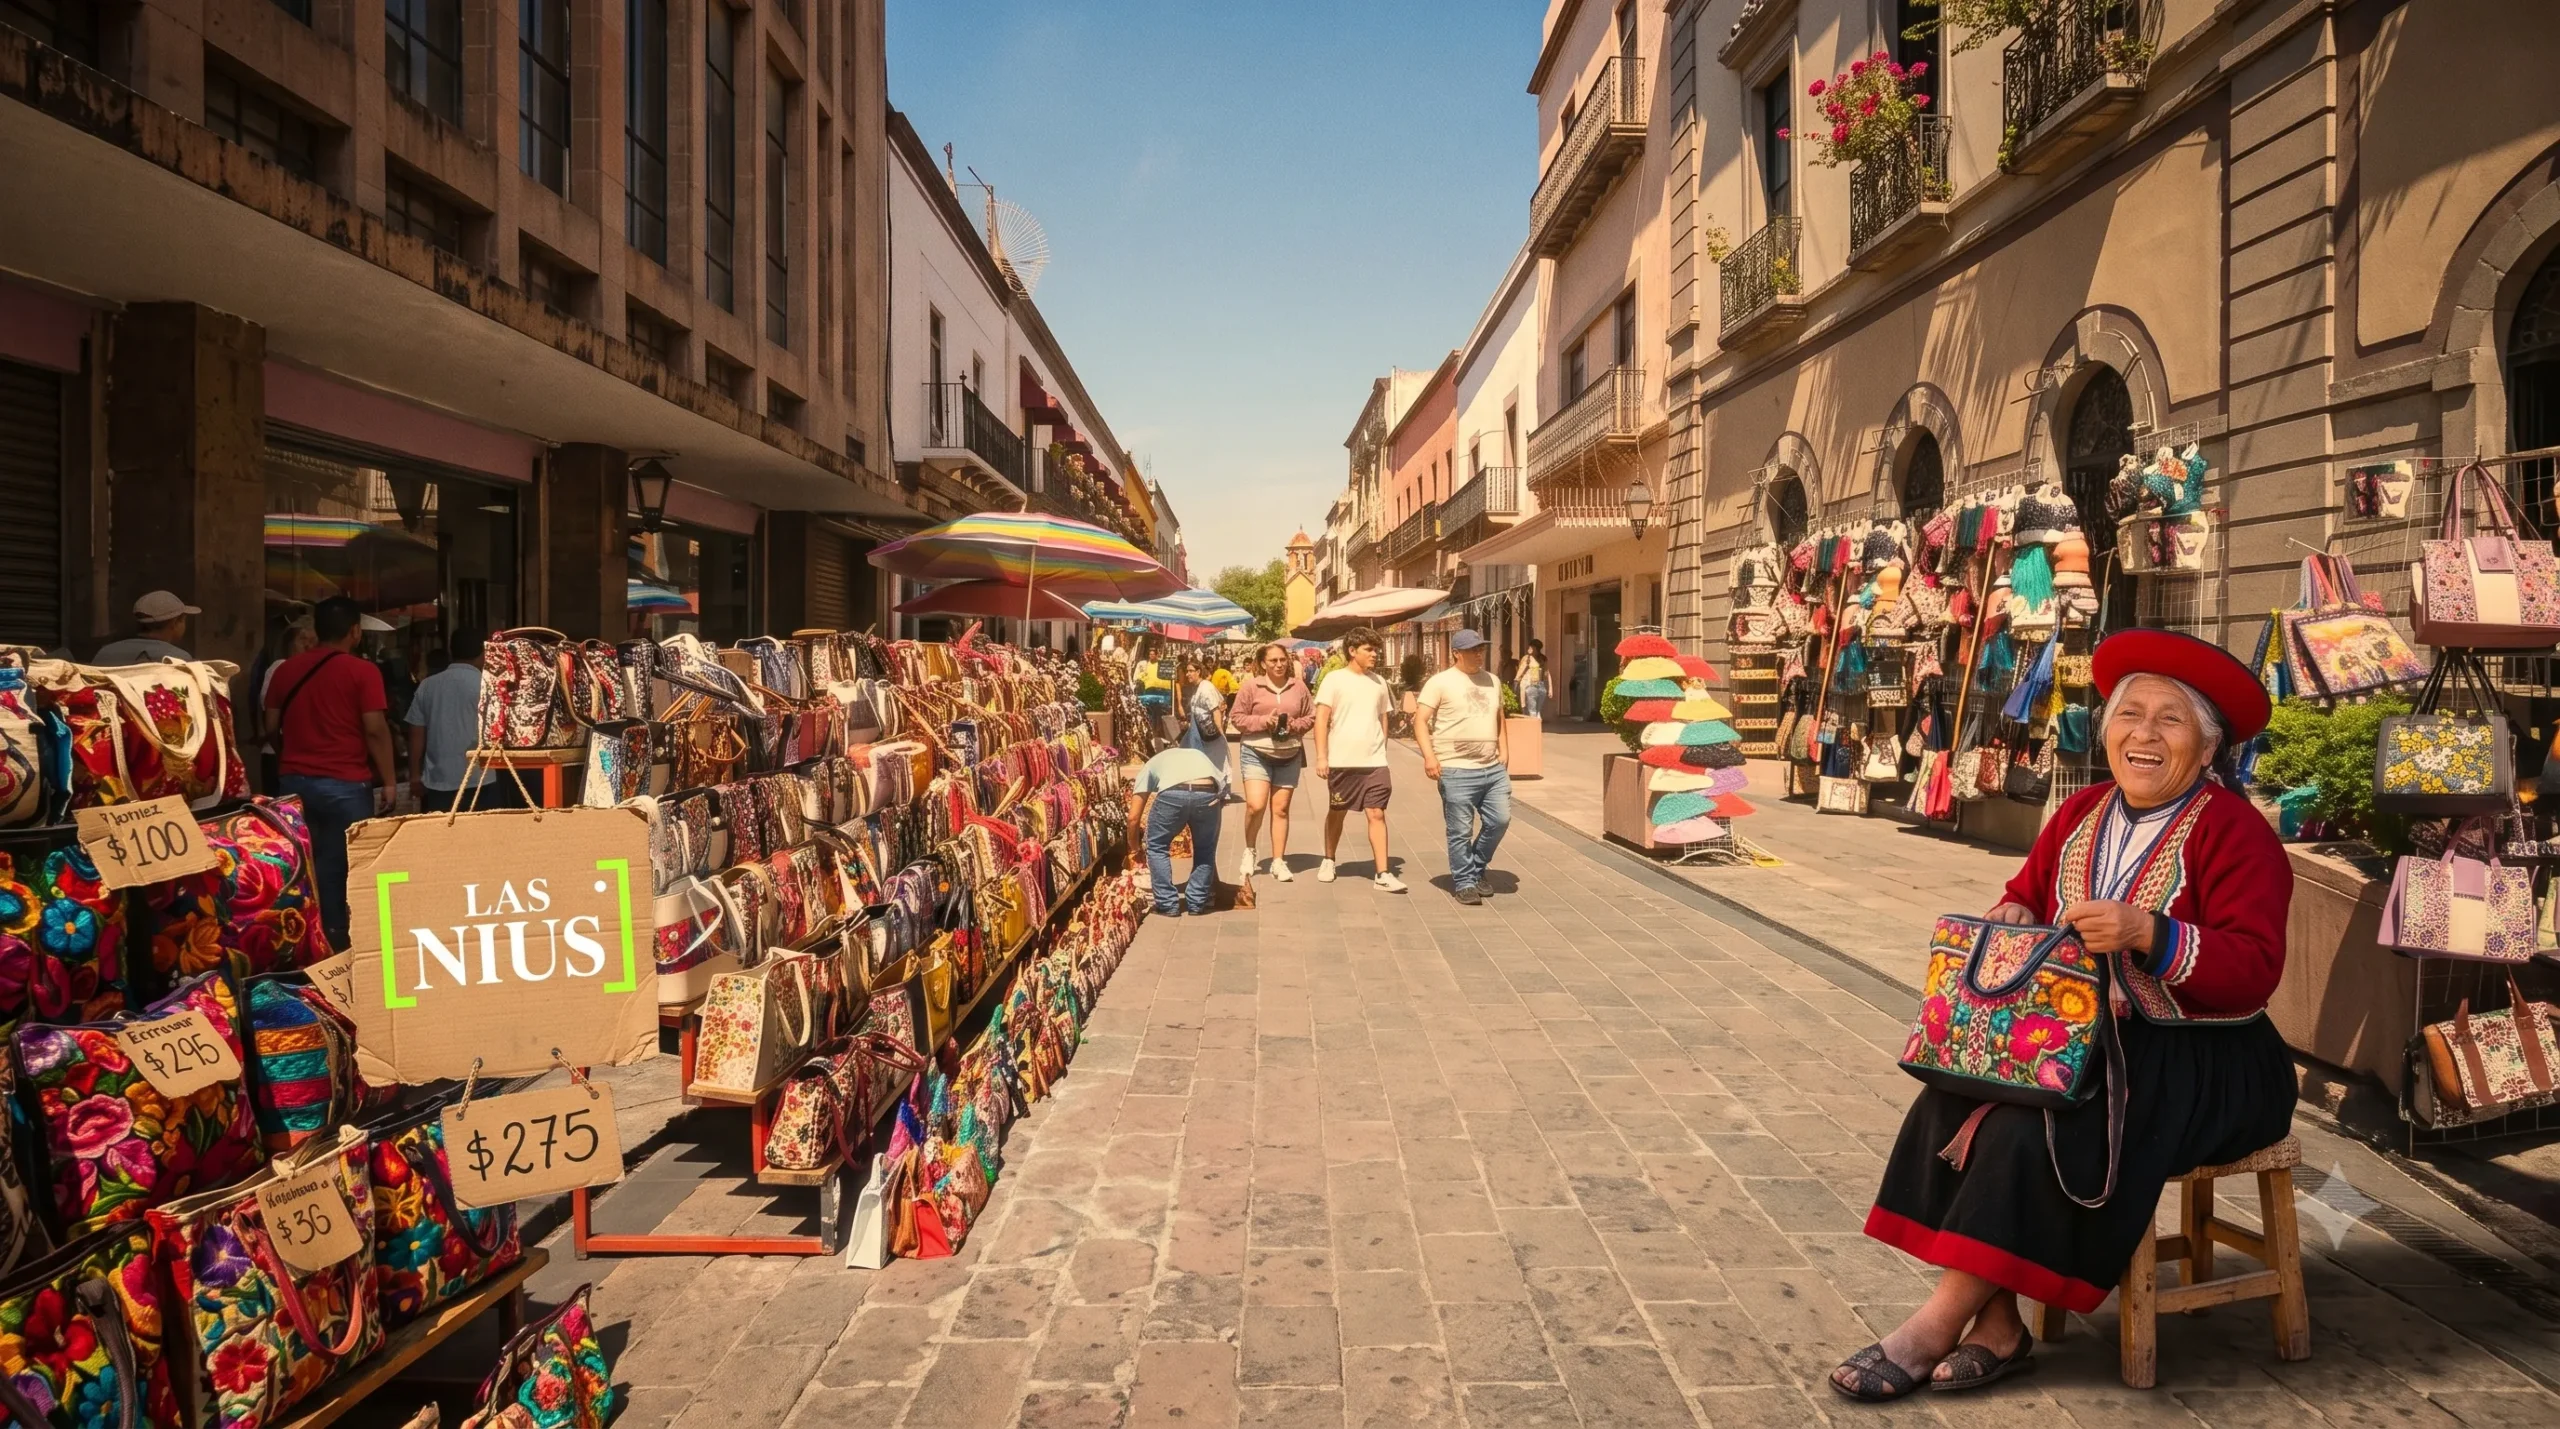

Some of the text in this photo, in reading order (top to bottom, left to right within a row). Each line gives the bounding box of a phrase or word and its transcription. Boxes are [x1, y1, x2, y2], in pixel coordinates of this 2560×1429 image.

[107, 821, 189, 867] $100
[462, 878, 551, 918] LAS
[409, 915, 606, 990] NIUS
[143, 1033, 220, 1079] $295
[466, 1108, 599, 1182] $275
[276, 1203, 332, 1246] $36
